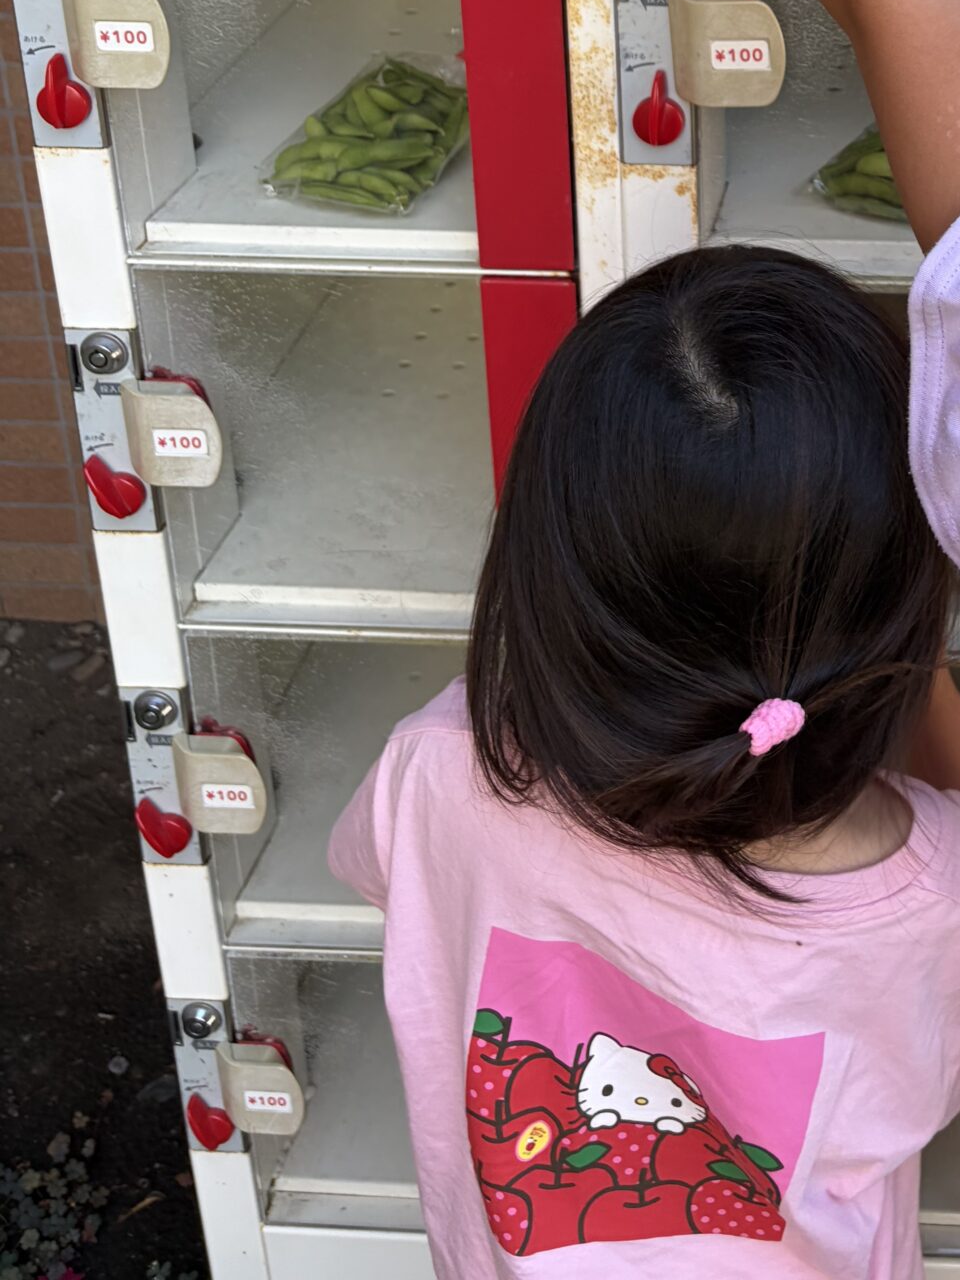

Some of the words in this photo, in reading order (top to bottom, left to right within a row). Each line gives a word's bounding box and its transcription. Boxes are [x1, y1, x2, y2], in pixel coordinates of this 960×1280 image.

[100, 30, 148, 45] ¥100
[715, 48, 764, 62] ¥100
[158, 436, 202, 450] ¥100
[206, 790, 249, 802] ¥100
[248, 1096, 287, 1107] ¥100
